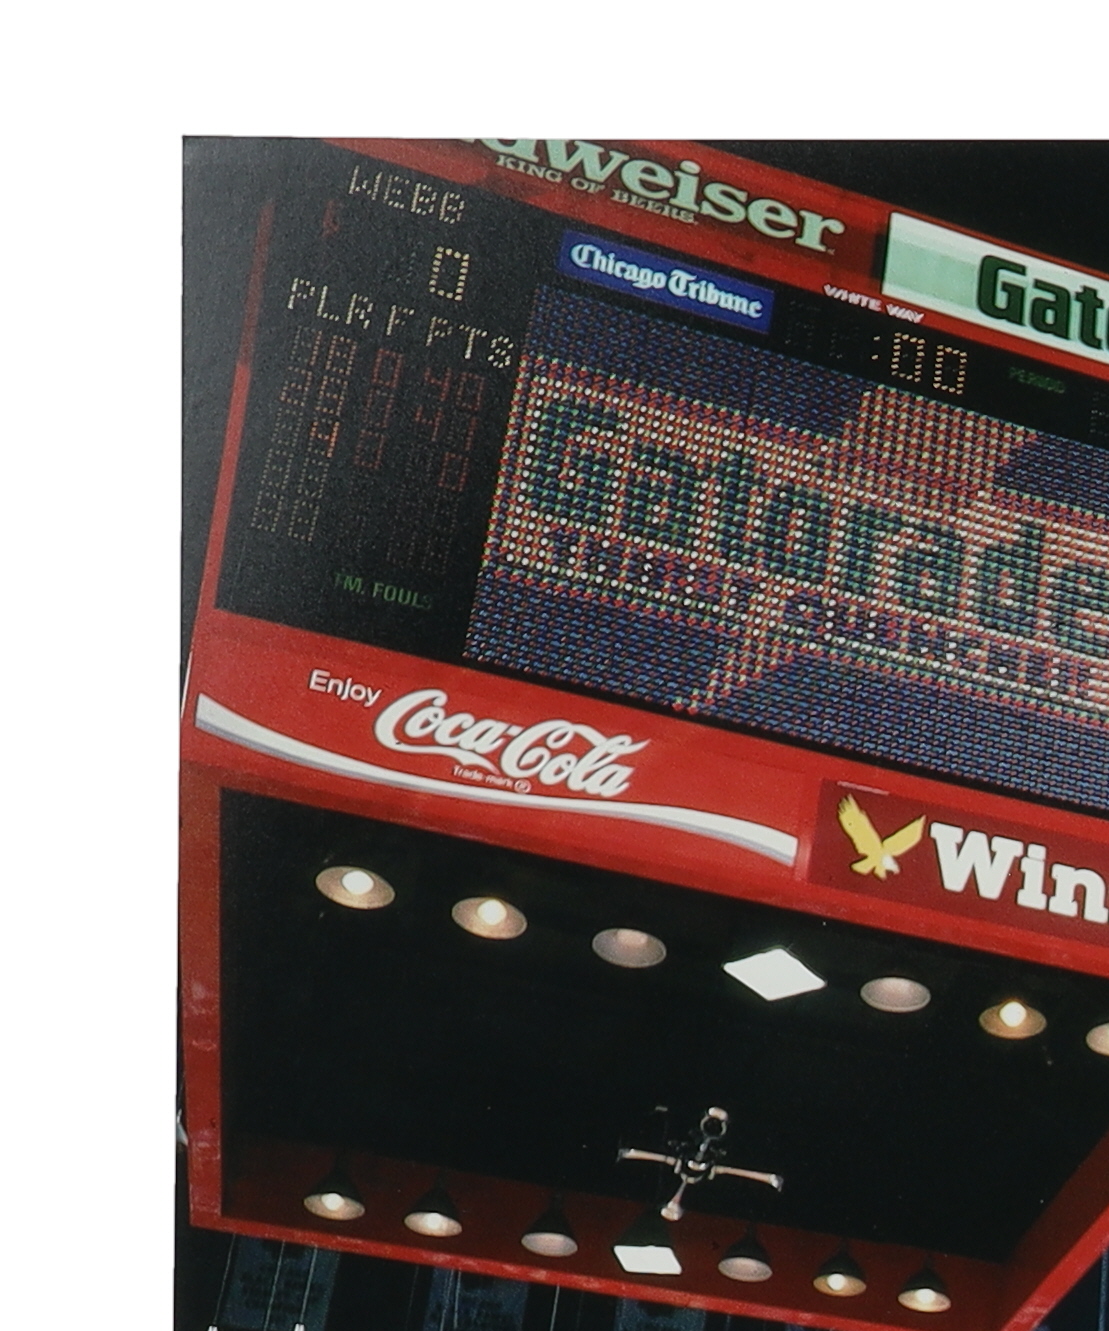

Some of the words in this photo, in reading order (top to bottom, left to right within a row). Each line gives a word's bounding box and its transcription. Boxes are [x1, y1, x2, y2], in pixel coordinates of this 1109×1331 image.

[348, 164, 465, 224] WEBB
[450, 139, 846, 252] weiser
[496, 154, 563, 184] KING
[570, 177, 606, 194] OF
[428, 245, 471, 301] 0
[570, 243, 668, 290] Chicago
[667, 267, 764, 320] Tribune
[287, 277, 374, 330] PLR
[386, 304, 416, 337] F
[425, 315, 515, 370] PTS
[309, 668, 383, 708] Enjoy
[374, 687, 652, 798] Coca-Cola
